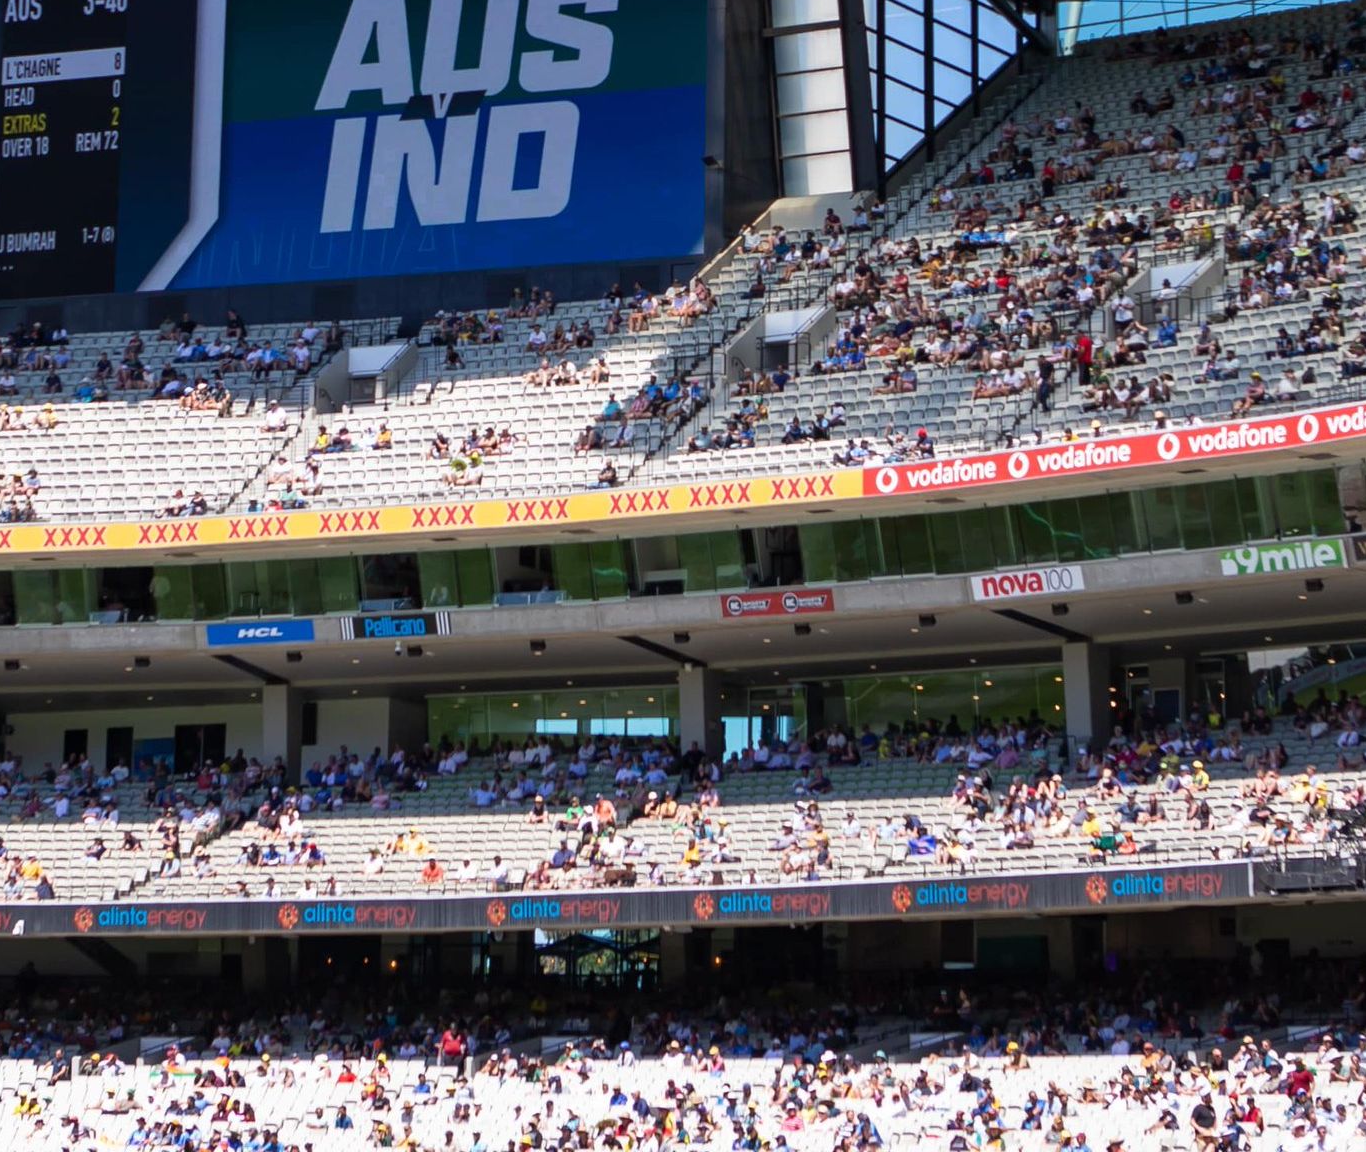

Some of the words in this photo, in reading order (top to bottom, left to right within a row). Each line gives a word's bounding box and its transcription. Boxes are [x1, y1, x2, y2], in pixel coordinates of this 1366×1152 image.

[6, 57, 61, 81] L'CHAGNE
[114, 52, 122, 70] 8
[4, 87, 35, 108] HEAD
[112, 79, 121, 98] 0
[3, 113, 47, 135] EXTRAS
[111, 107, 120, 126] 2
[2, 138, 32, 158] OVER
[36, 136, 49, 155] 18
[75, 132, 101, 152] REM
[104, 131, 119, 150] 72
[320, 100, 580, 233] IND
[7, 231, 56, 252] BUMRAH
[83, 227, 100, 244] 1-7
[1188, 423, 1286, 455] vodafone
[1037, 441, 1131, 473] vodafone
[907, 460, 996, 488] vodafone
[690, 483, 750, 506] XXXX
[772, 475, 834, 499] XXXX
[507, 499, 569, 521] XXXX
[610, 490, 669, 513] XXXX
[229, 516, 288, 538] XXXX
[320, 510, 380, 533] XXXX
[412, 504, 473, 527] XXXX
[44, 527, 106, 547] XXXX
[139, 522, 198, 544] XXXX
[237, 627, 283, 638] HCL
[364, 616, 426, 638] Pellicano
